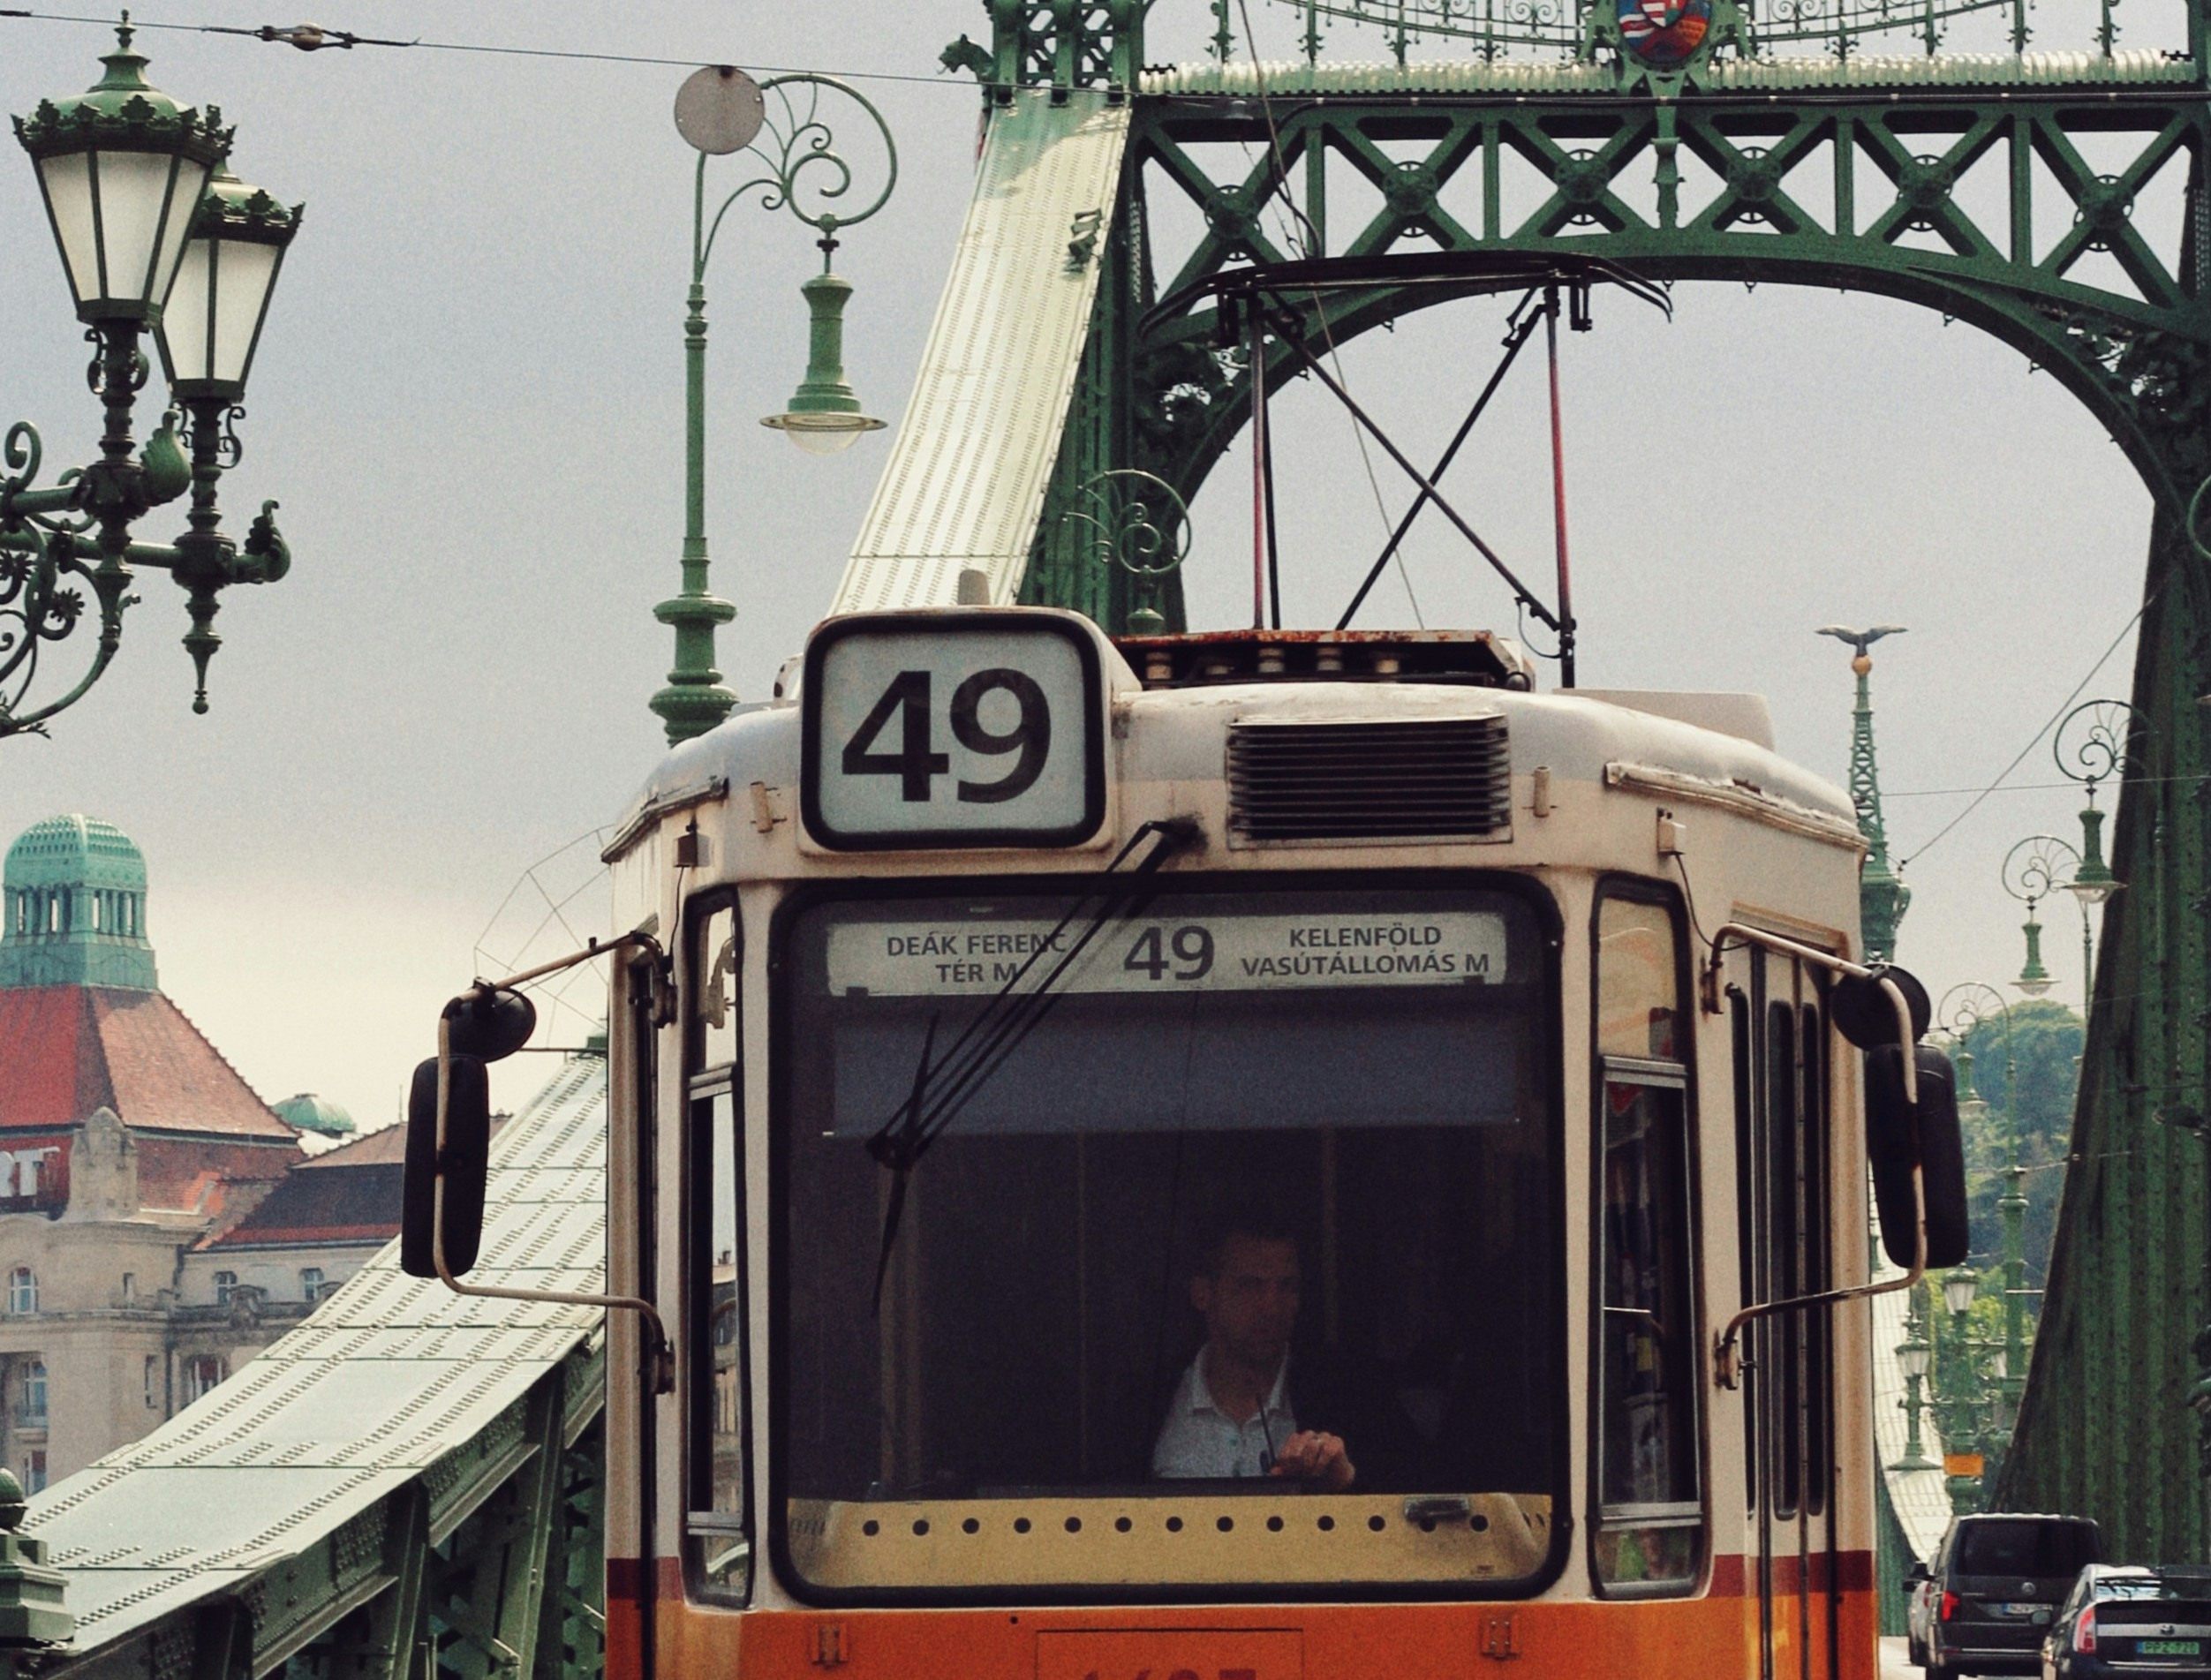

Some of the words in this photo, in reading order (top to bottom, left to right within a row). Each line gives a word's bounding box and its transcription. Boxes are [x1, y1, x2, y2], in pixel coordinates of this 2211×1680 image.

[841, 667, 1052, 804] 49
[887, 930, 958, 956] DEÁK
[967, 932, 1067, 954] FERENC
[1290, 923, 1442, 948] KELENFÖLD
[1123, 925, 1215, 981] 49
[1241, 949, 1456, 976] VASÚTÁLLOMÁS
[1465, 953, 1490, 973] M
[935, 958, 985, 983] TÉR
[993, 962, 1018, 983] M
